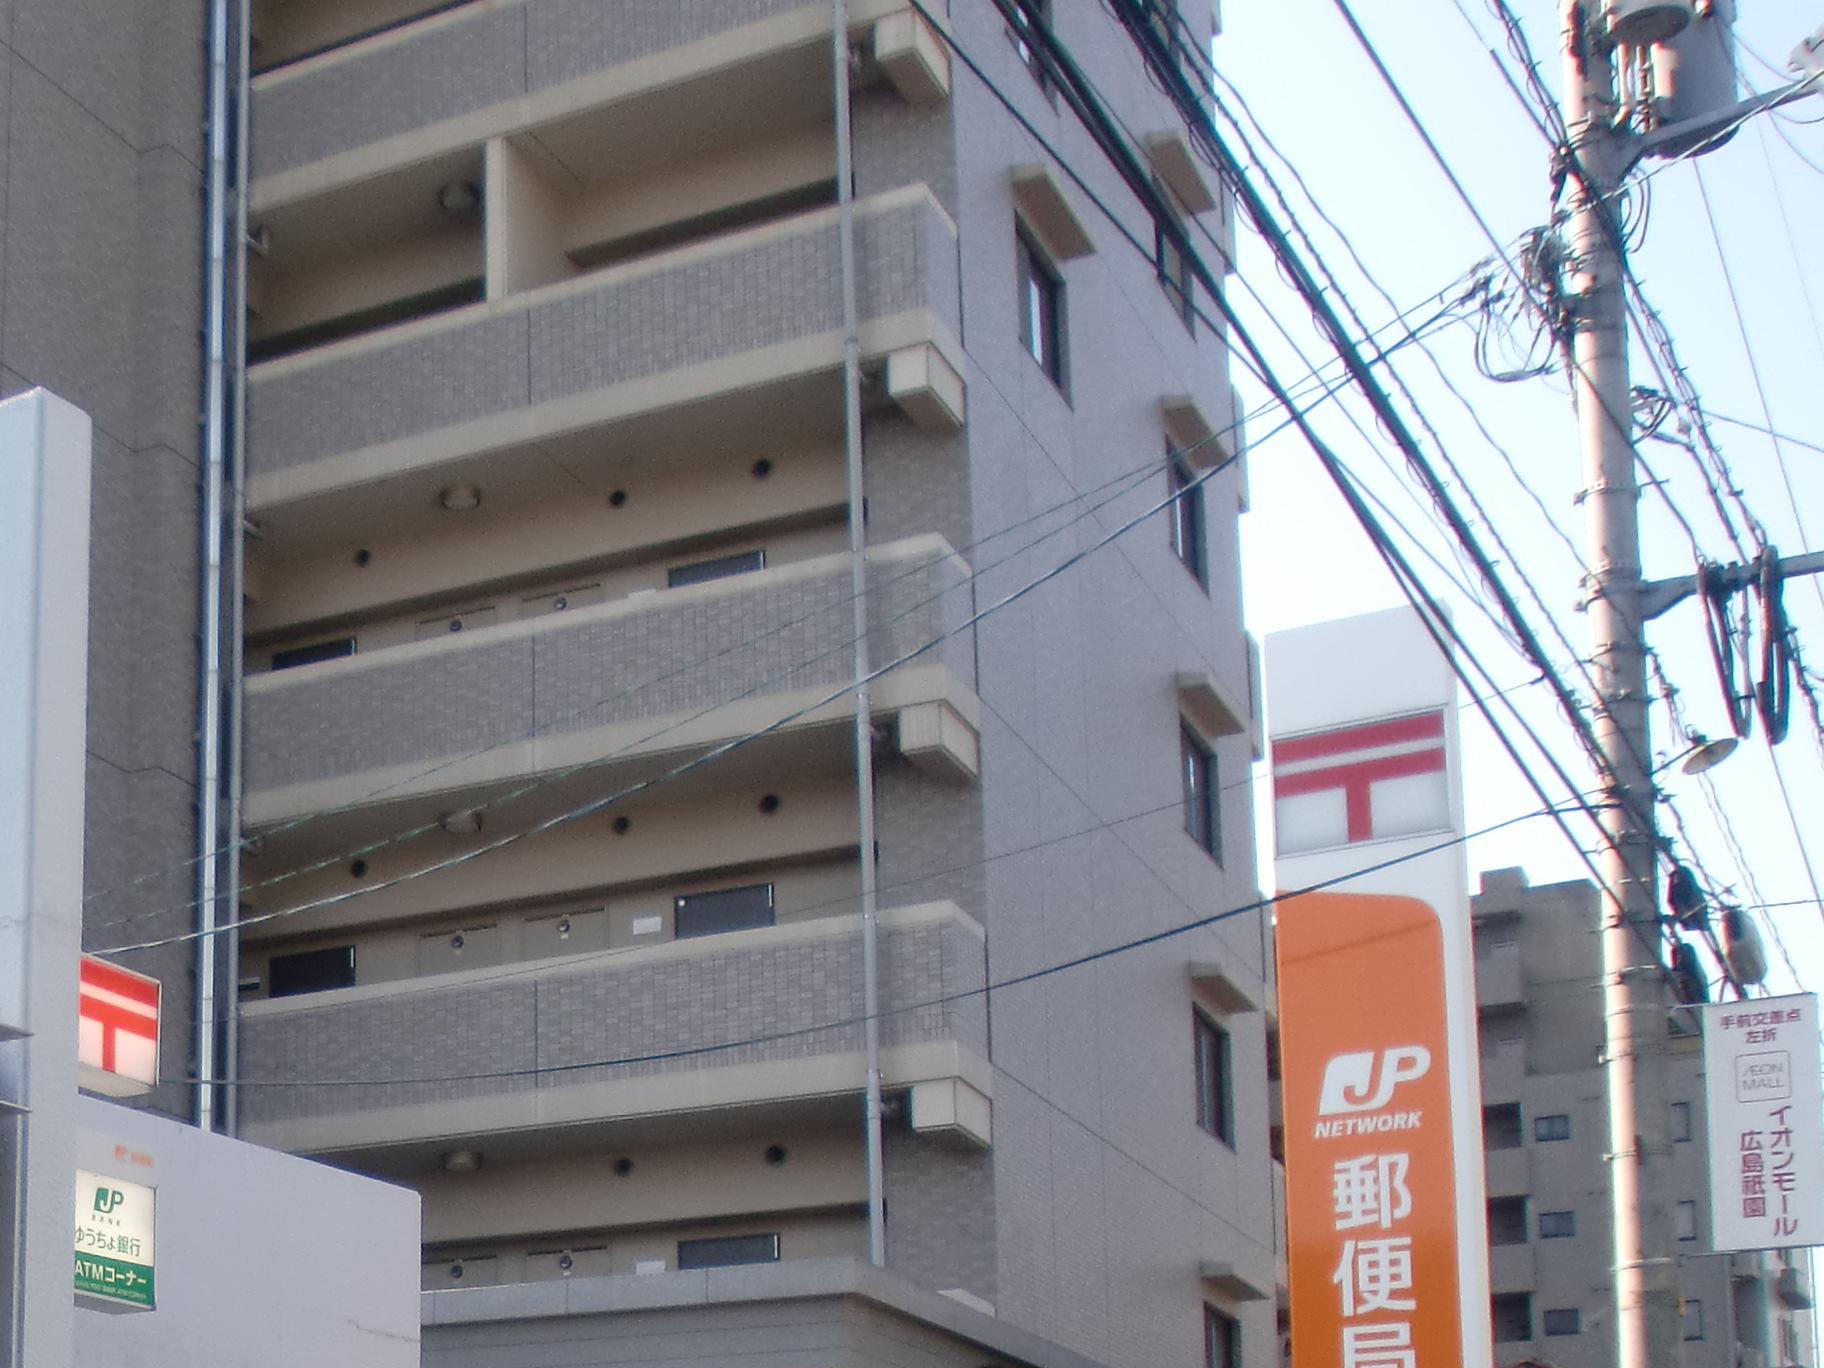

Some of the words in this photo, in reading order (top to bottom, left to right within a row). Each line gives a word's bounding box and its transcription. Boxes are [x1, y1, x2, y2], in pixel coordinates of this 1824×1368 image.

[1720, 1009, 1802, 1029] 手前交差点
[1745, 1028, 1777, 1044] 左折
[1743, 1077, 1785, 1091] MALL
[1314, 1111, 1423, 1139] NETWORK
[1740, 1130, 1766, 1218] 広島祇園
[1769, 1105, 1799, 1237] イオンモール
[91, 1214, 121, 1227] BANK
[75, 1226, 141, 1257] ゆうちょ銀行
[75, 1259, 147, 1287] ATMコーナー
